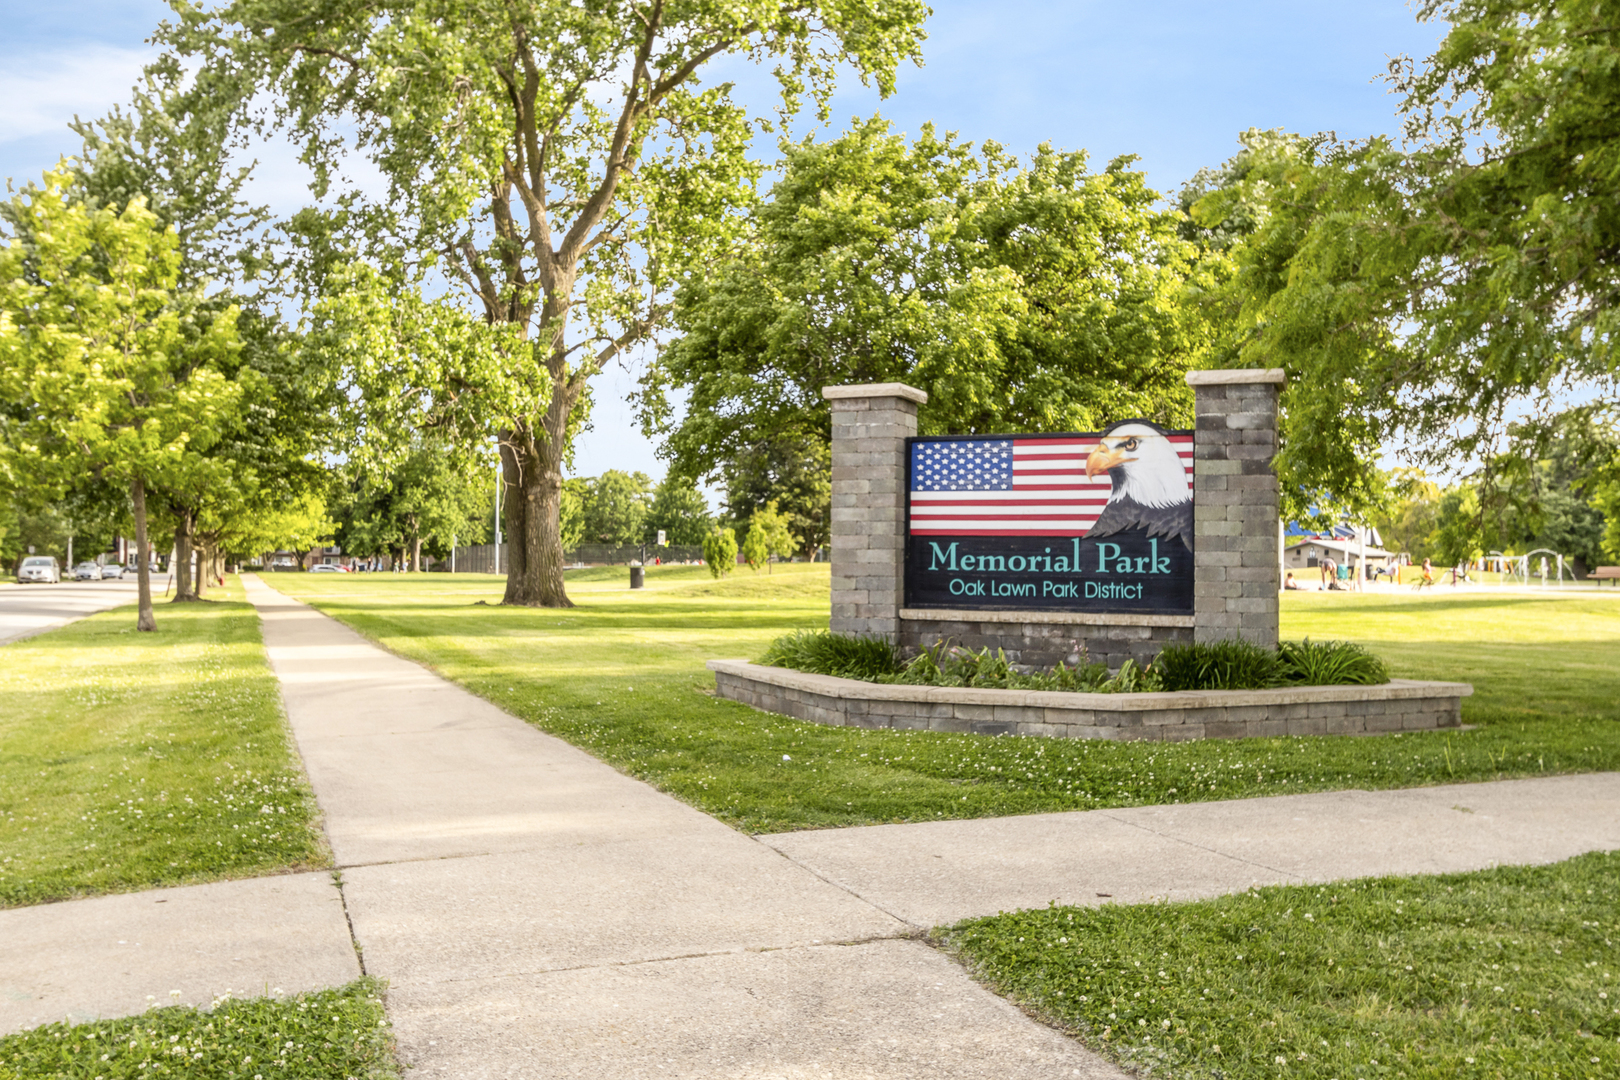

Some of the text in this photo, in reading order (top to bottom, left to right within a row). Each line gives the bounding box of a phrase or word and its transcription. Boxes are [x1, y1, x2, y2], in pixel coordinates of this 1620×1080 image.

[928, 538, 1171, 574] Memorial Park
[949, 579, 1143, 599] Oak Lawn Park District
